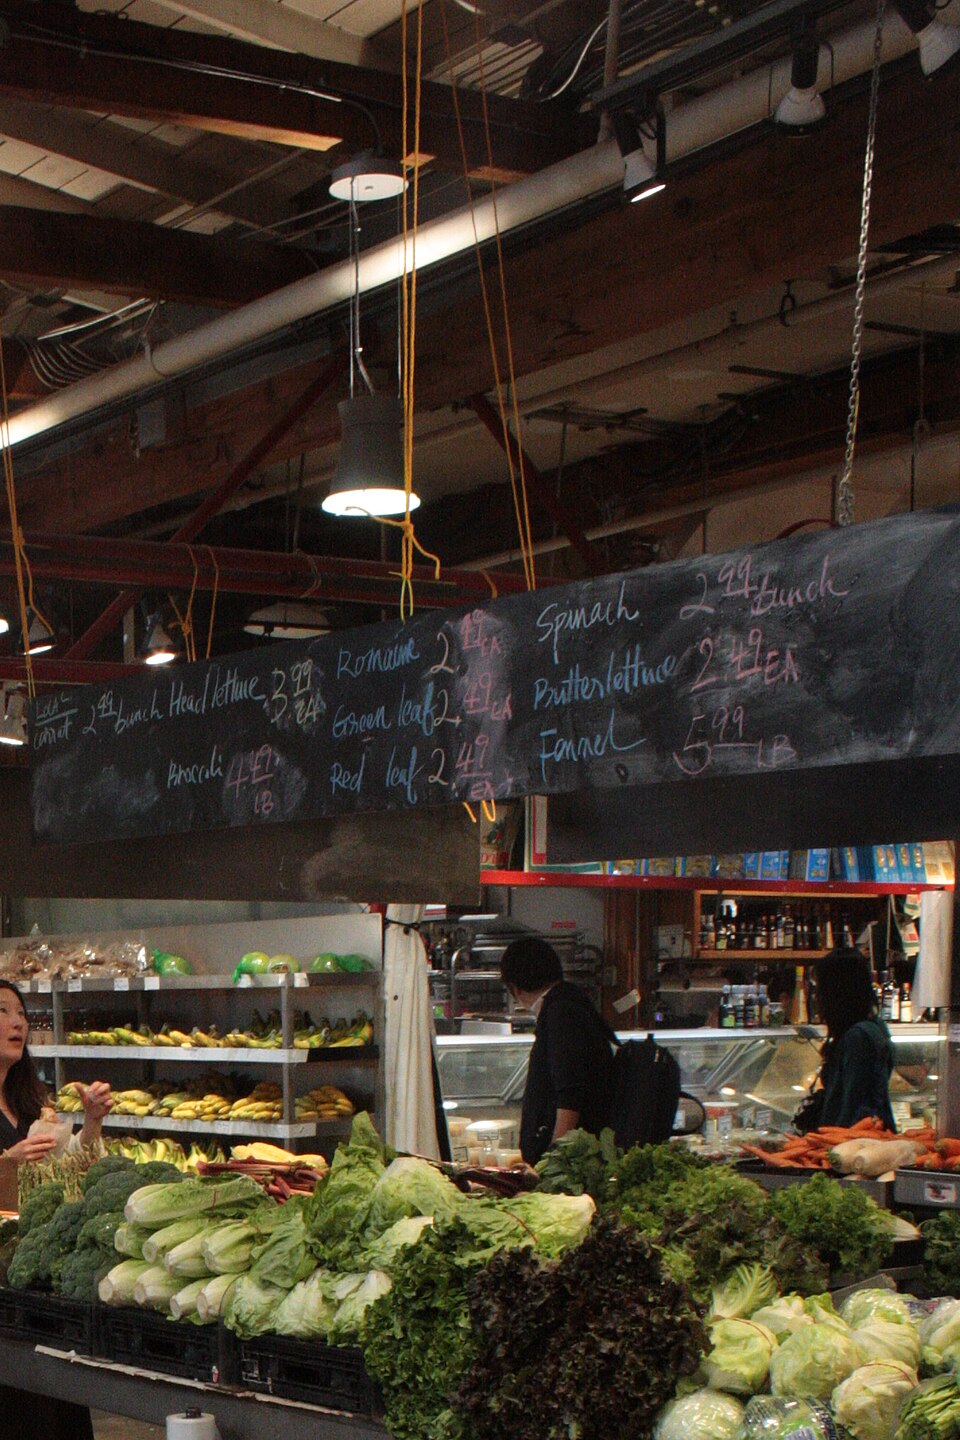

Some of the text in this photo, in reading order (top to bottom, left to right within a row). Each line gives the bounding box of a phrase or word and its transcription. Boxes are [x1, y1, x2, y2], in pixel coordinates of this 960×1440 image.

[536, 580, 639, 665] Spinach
[337, 637, 420, 679] Romaine
[333, 704, 390, 738] Green
[397, 680, 437, 737] leaf
[330, 752, 365, 795] Red
[386, 745, 424, 804] leaf
